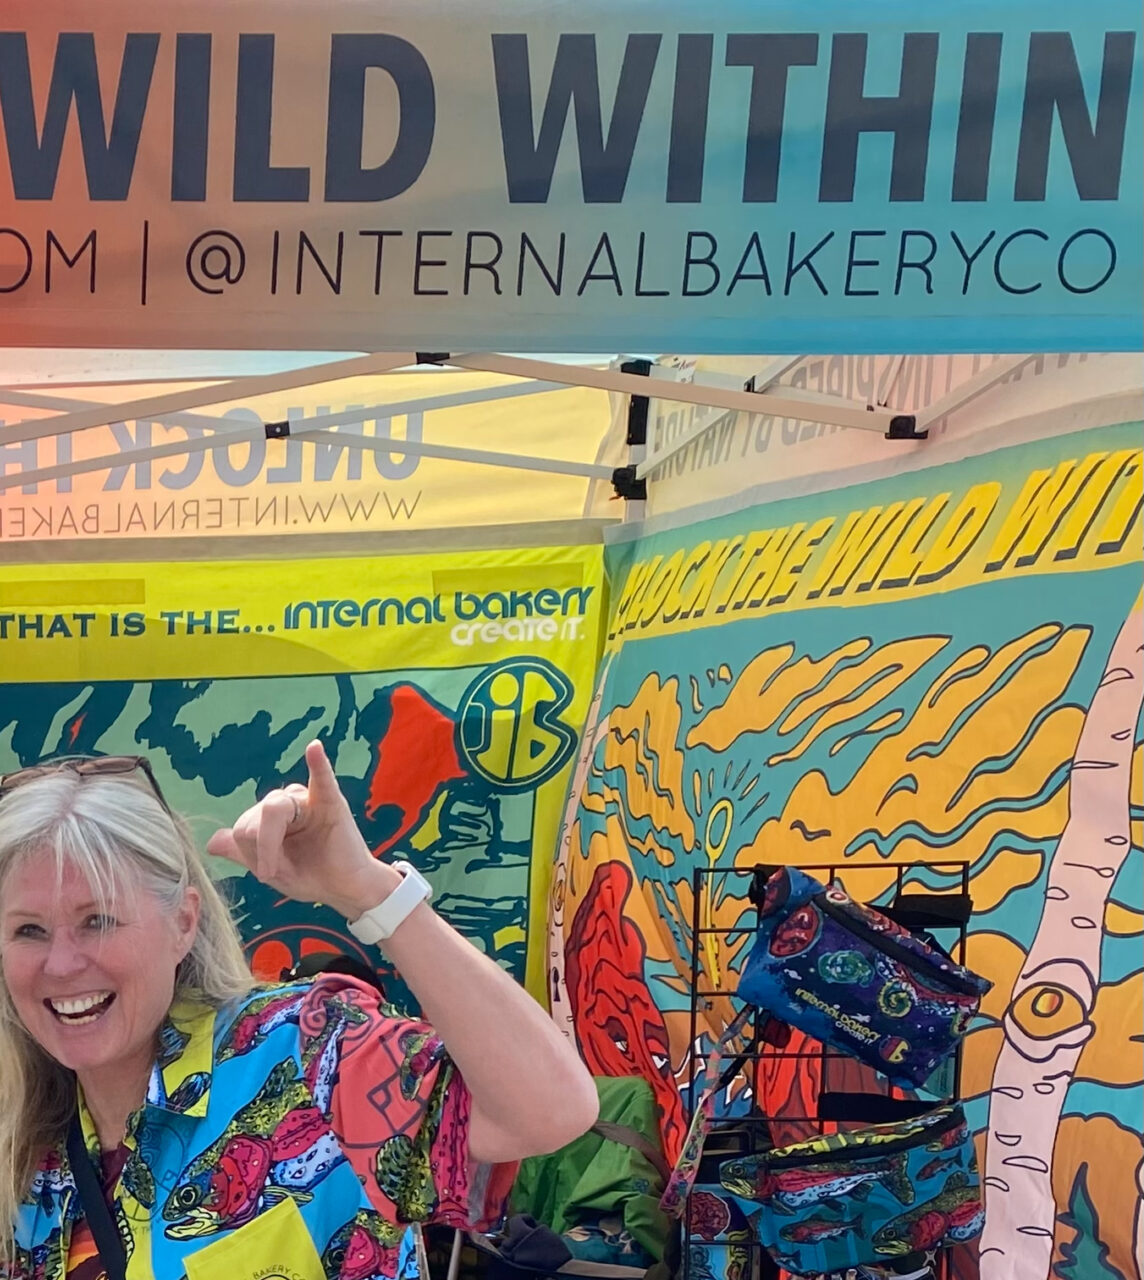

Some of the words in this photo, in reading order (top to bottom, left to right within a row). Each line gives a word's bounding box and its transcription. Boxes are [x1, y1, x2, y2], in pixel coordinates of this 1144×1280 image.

[491, 31, 1137, 204] WITHIN
[186, 228, 1118, 297] @INTERNALBAKERYCO
[716, 516, 836, 613] THE
[808, 481, 1001, 600] WILD
[111, 610, 146, 637] IS
[252, 1264, 291, 1280] BAKERY
